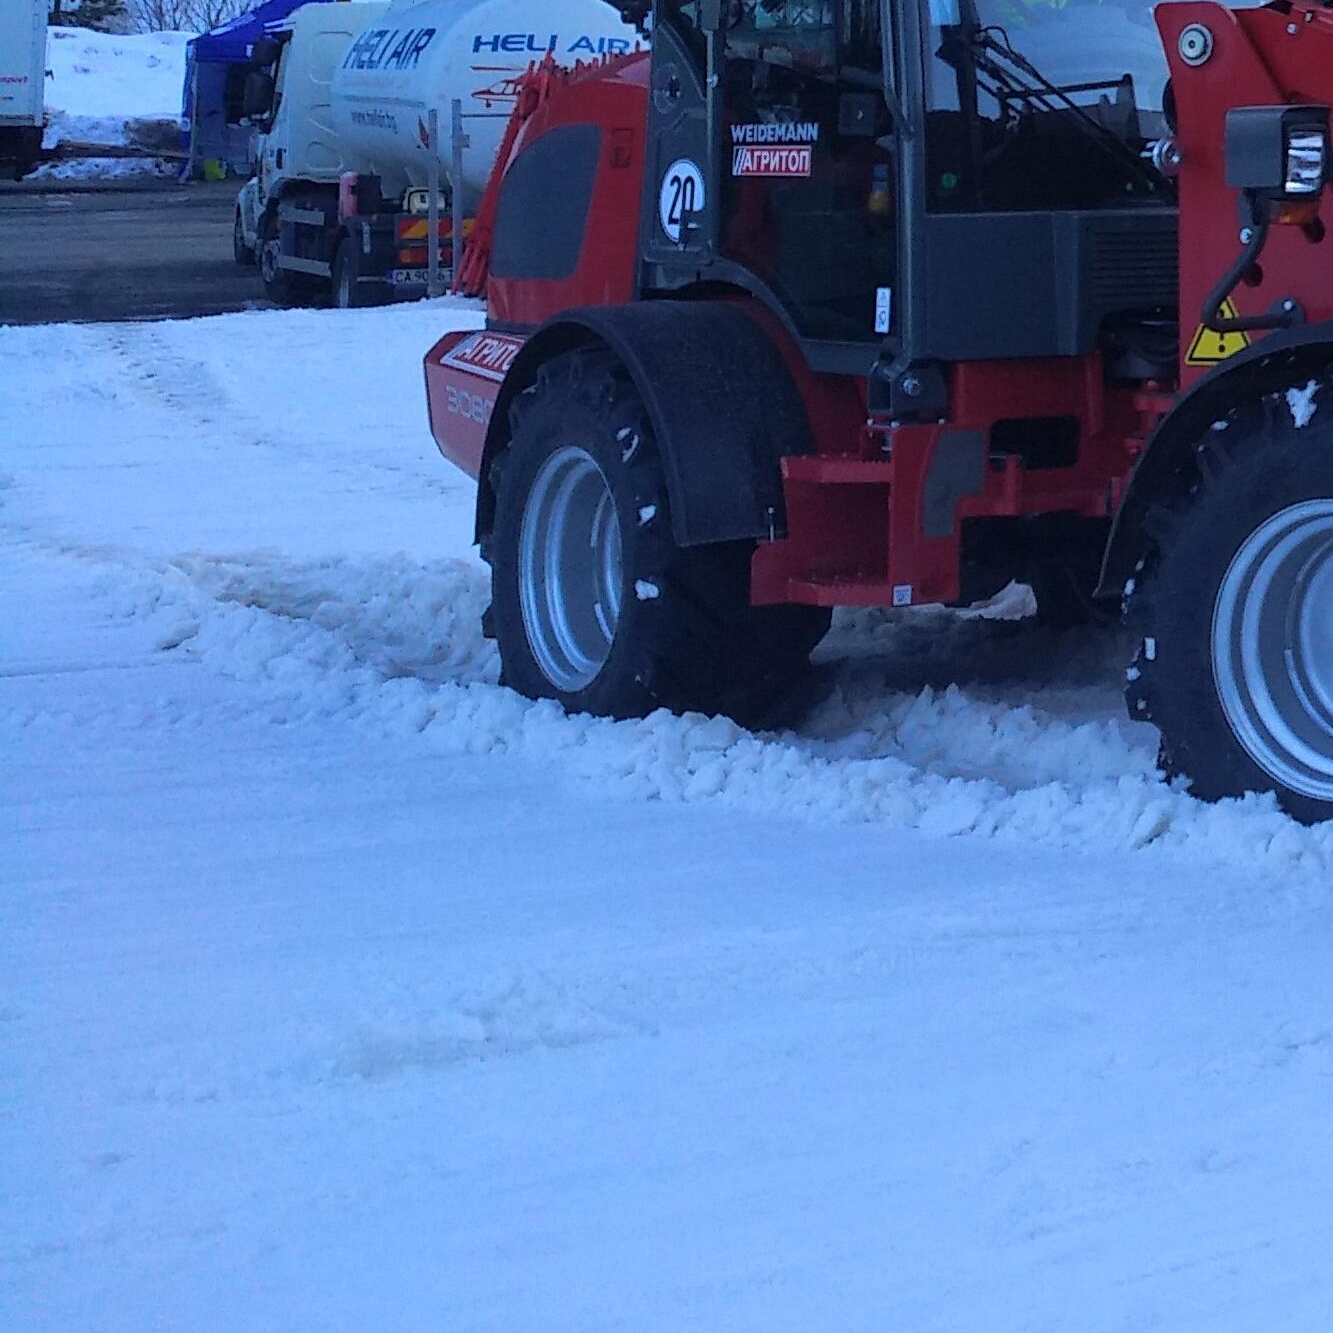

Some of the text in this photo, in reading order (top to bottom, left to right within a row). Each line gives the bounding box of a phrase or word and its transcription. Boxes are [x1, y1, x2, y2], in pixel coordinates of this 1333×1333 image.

[342, 28, 436, 69] HELI AIR
[473, 33, 631, 55] HELI AIR
[730, 122, 819, 143] WEIDEMANN
[742, 148, 810, 172] АГРИТОП
[668, 175, 696, 225] 20
